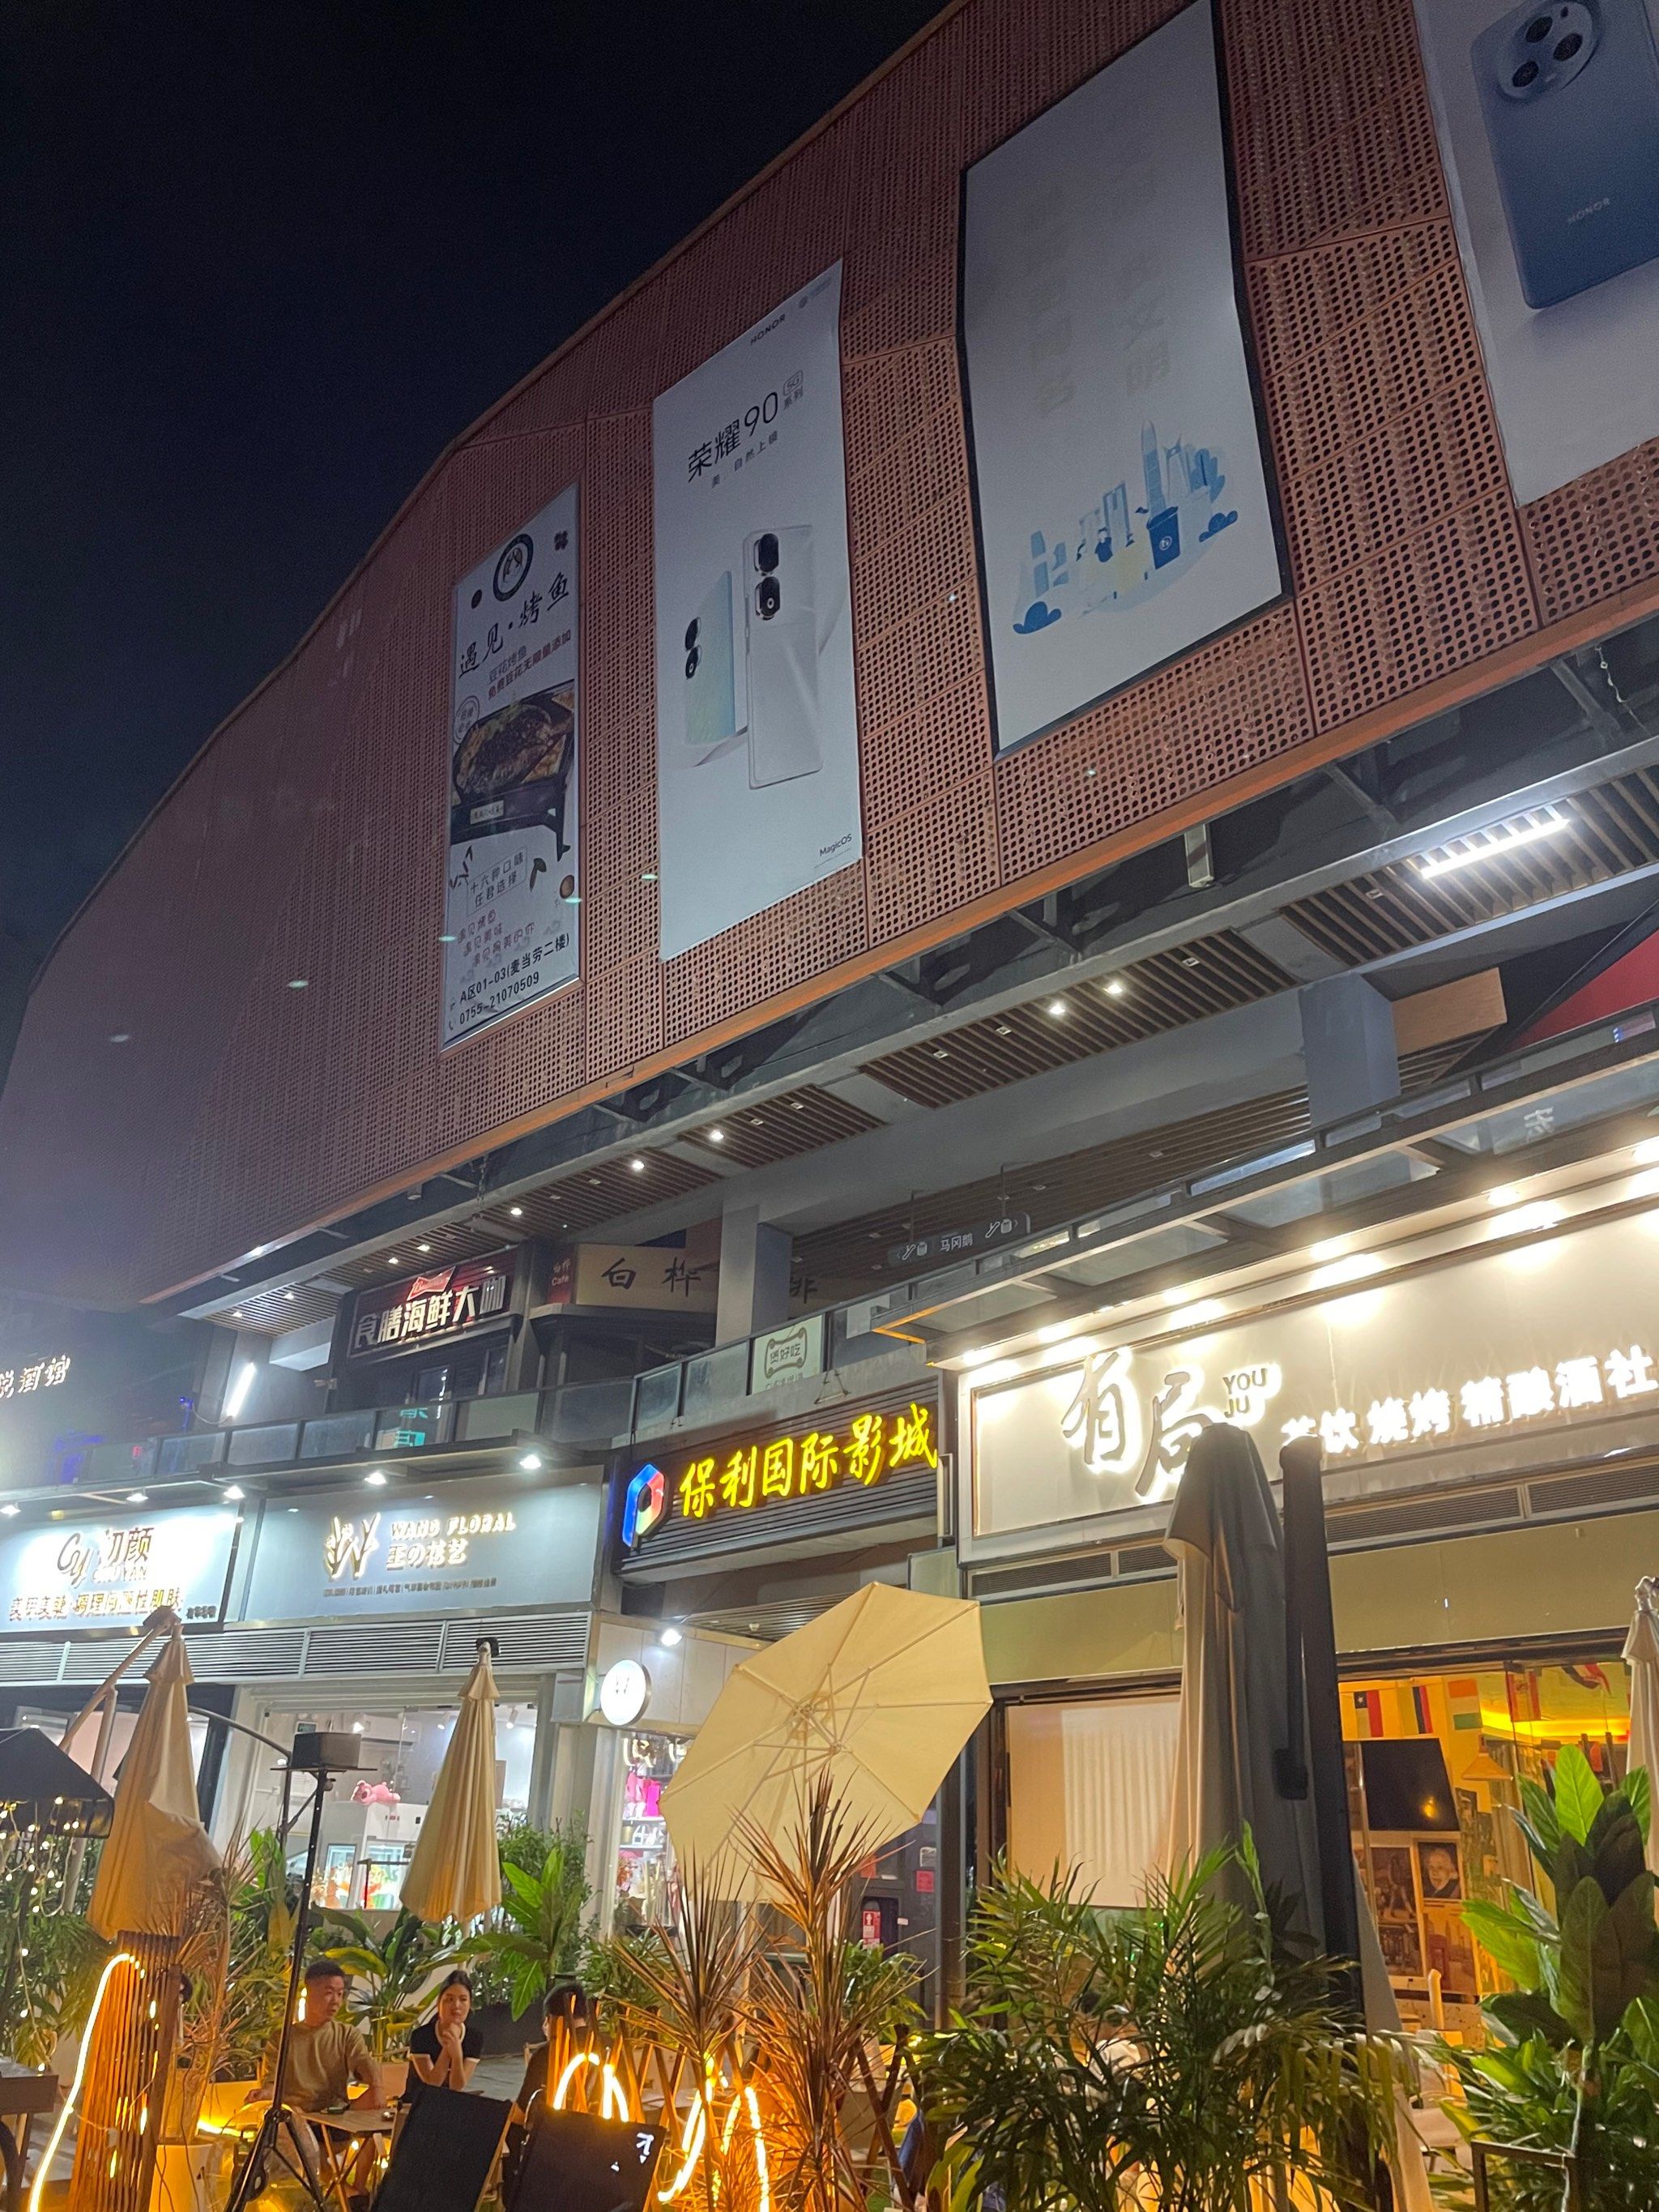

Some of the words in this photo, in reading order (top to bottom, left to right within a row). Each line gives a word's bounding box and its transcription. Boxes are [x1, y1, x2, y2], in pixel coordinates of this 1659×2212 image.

[750, 314, 786, 345] HONOR
[689, 392, 778, 483] 荣耀90
[820, 834, 852, 856] MagicOS
[459, 971, 539, 1024] 0755-21070509
[1222, 1368, 1269, 1394] YOU
[1223, 1395, 1250, 1419] JU
[679, 1402, 938, 1518] 保利国际影城
